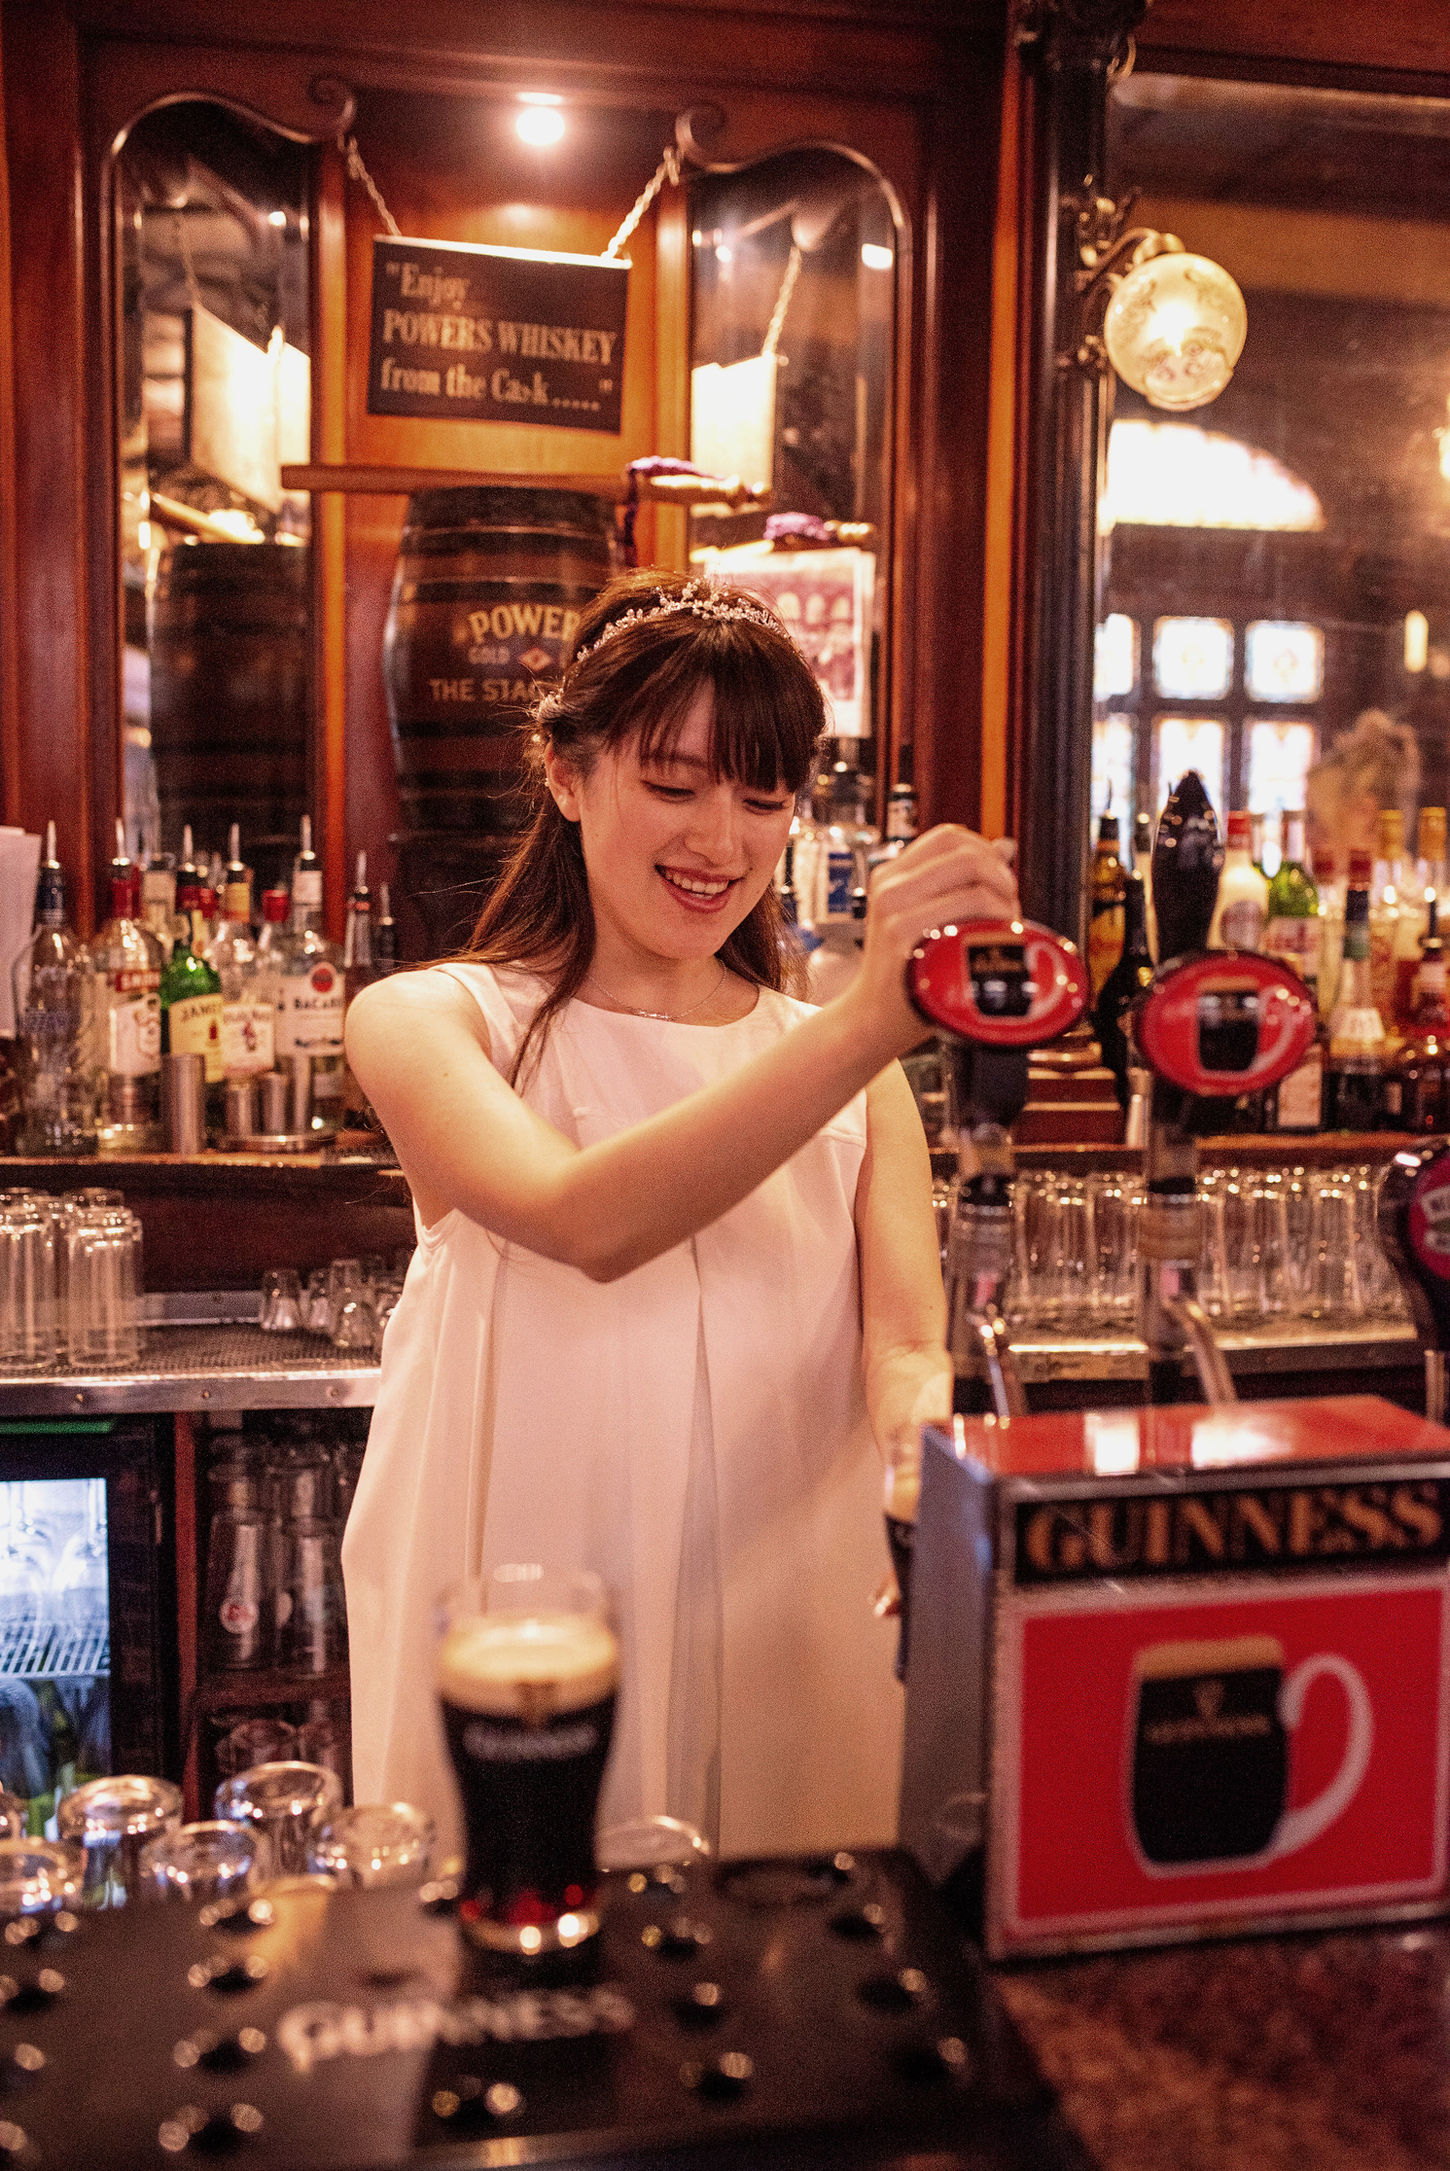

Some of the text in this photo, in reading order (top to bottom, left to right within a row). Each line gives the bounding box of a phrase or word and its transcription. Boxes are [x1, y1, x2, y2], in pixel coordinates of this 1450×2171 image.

[383, 309, 617, 365] POWERS WHISKEY
[381, 357, 440, 396] from
[446, 363, 487, 399] the
[428, 678, 475, 701] THE
[1026, 1484, 1442, 1570] GUINNESS
